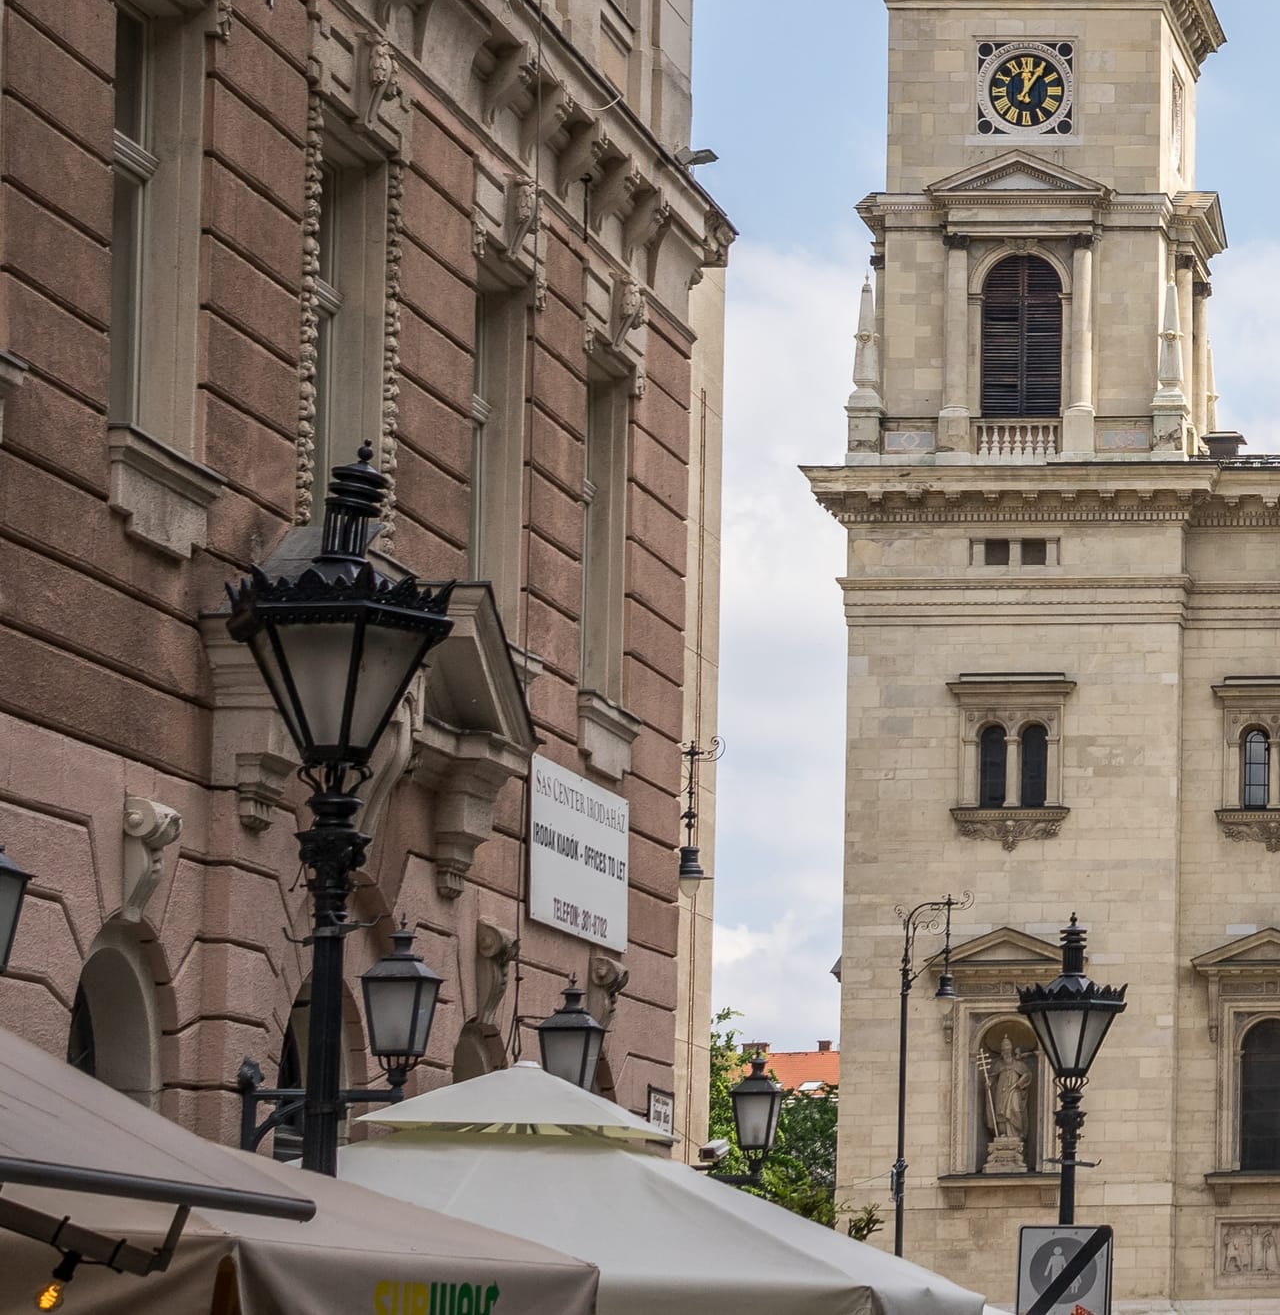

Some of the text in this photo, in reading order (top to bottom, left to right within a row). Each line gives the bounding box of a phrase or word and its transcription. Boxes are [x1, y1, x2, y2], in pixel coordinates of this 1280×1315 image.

[1006, 60, 1020, 76] XI
[995, 71, 1011, 84] X
[1044, 72, 1058, 83] II
[1048, 87, 1061, 95] III
[1036, 109, 1046, 122] V
[536, 769, 626, 834] SAS CENTER IRODAHÁZ
[532, 820, 557, 852] IRODÁK
[556, 832, 579, 861] KIADÓK
[584, 844, 607, 874] OFFICES
[608, 855, 616, 878] TO
[616, 859, 626, 883] LET
[553, 896, 580, 928] TELEFON:
